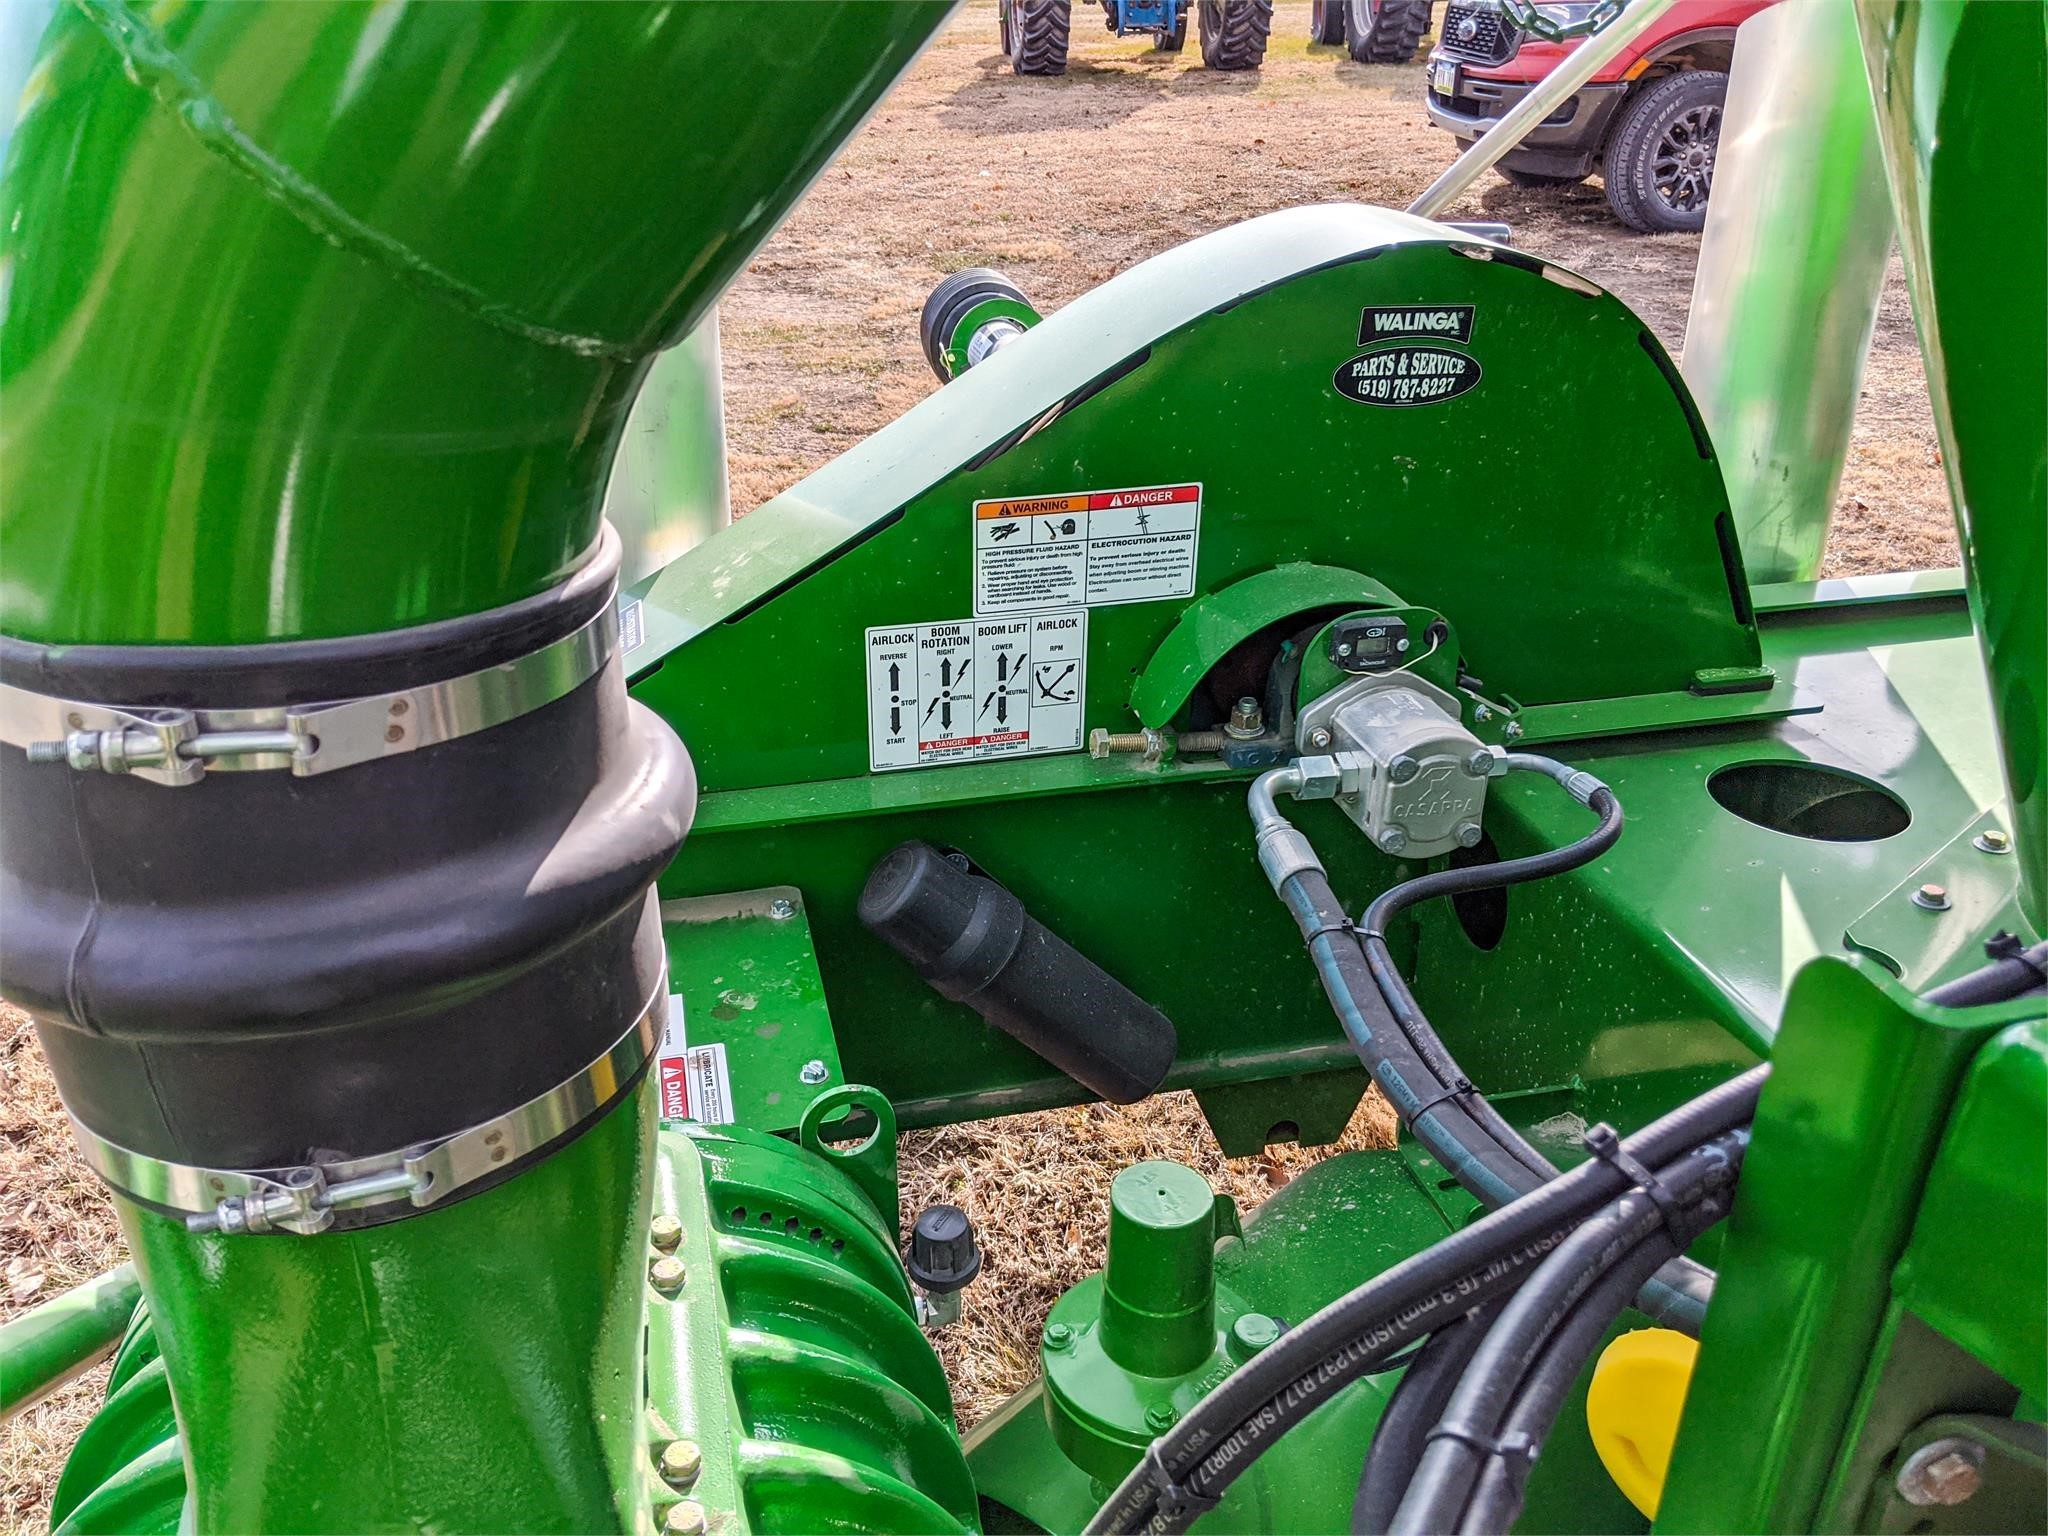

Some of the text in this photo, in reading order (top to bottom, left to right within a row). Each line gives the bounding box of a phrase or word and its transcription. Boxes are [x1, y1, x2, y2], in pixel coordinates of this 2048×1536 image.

[1374, 312, 1460, 331] WALINGA
[1352, 353, 1466, 377] PARTS & SERVICE
[1358, 378, 1455, 399] (519) 787-8227
[1124, 491, 1173, 504] DANGER
[1013, 500, 1068, 513] WARNING
[1092, 534, 1191, 549] ELECTROCUTION HAZARD
[1002, 548, 1034, 556] PRESSURE
[978, 623, 1027, 636] BOOM LIFT
[1037, 618, 1077, 631] AIRLOCK
[932, 626, 960, 637] BOOM
[872, 633, 914, 646] AIRLOCK
[922, 636, 970, 649] ROTATION
[937, 648, 955, 656] RIGHT
[992, 643, 1013, 651] LOWER
[880, 653, 907, 661] REVERSE
[886, 737, 906, 745] START
[935, 738, 968, 748] DANGER
[991, 733, 1022, 742] DANGER
[1393, 798, 1472, 817] CASAPPA
[702, 1051, 713, 1088] LUBRICATE
[1243, 1404, 1279, 1440] SAE
[1183, 1426, 1211, 1454] USA
[1200, 1432, 1249, 1484] 100R17
[1128, 1482, 1154, 1510] USA
